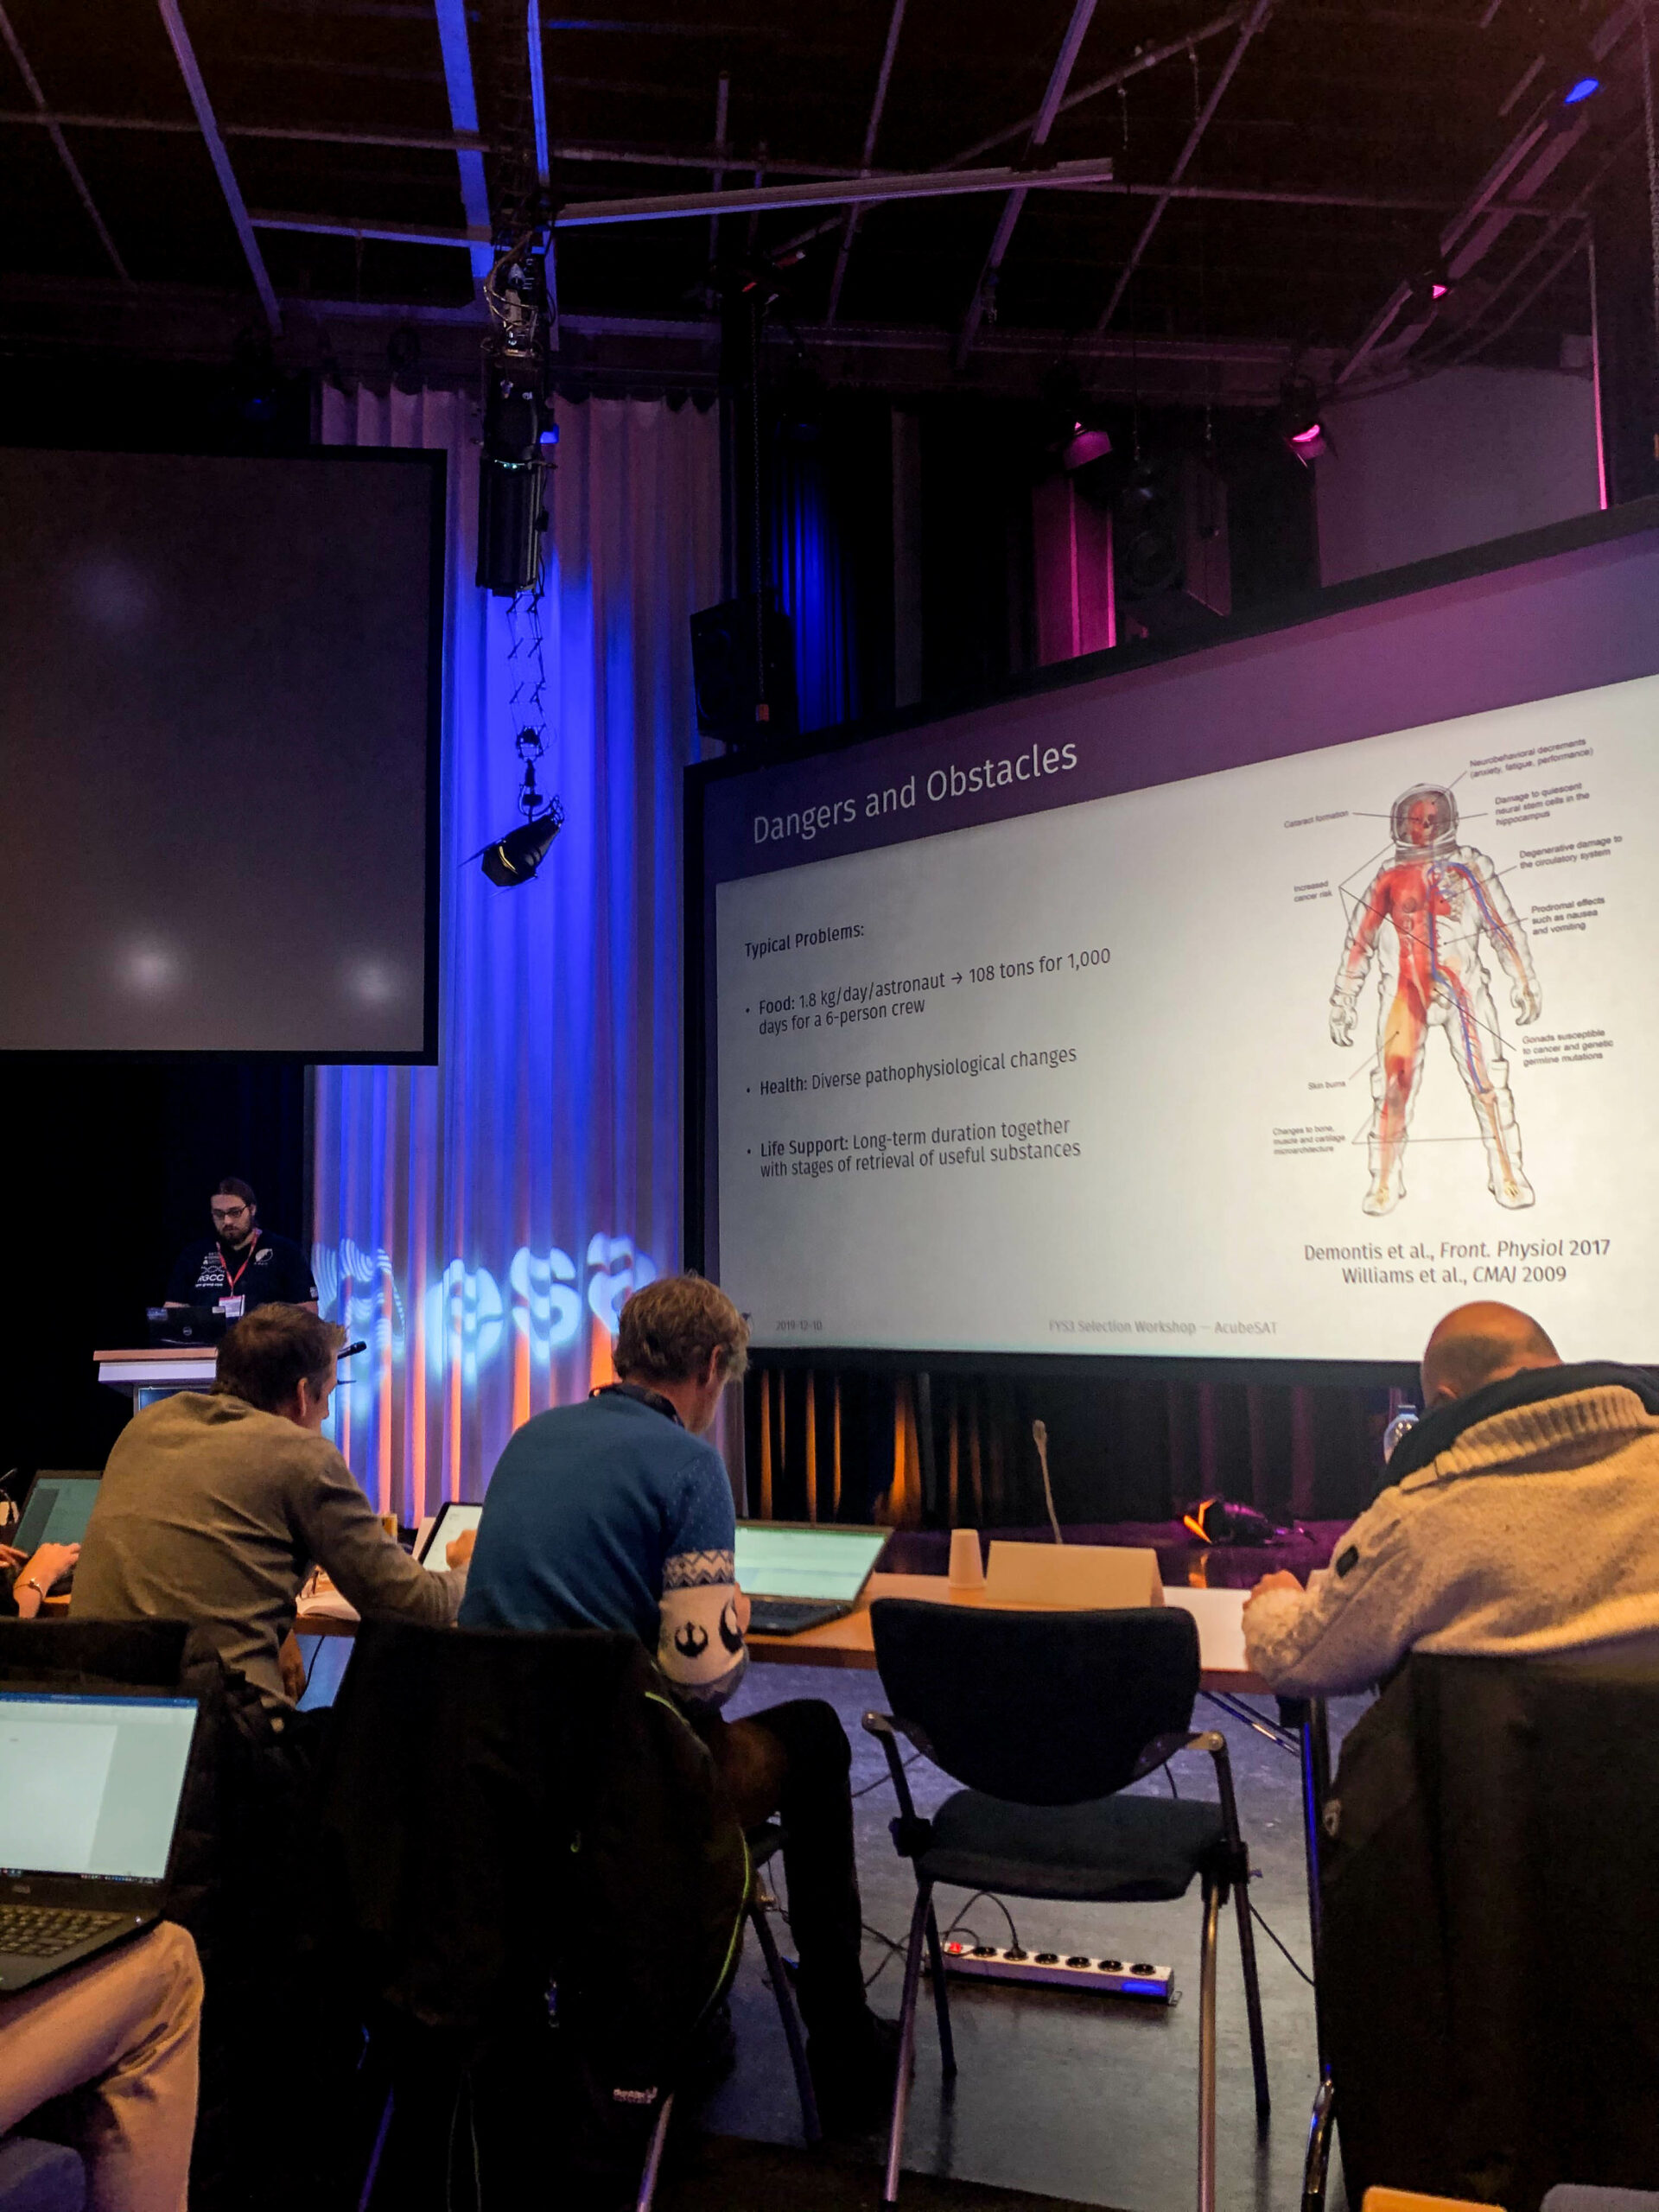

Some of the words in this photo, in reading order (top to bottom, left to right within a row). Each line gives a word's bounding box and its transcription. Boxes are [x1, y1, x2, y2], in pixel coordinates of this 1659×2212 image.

[753, 798, 856, 843] Dangers
[865, 776, 915, 817] and
[927, 743, 1077, 802] Obstacles
[1495, 792, 1529, 804] Damage
[1496, 804, 1521, 815] neural
[1523, 800, 1543, 810] stem
[1545, 797, 1564, 807] cells
[1576, 791, 1590, 800] the
[1496, 810, 1550, 826] hippocampus
[1519, 844, 1575, 859] Degenerative
[1576, 837, 1611, 848] damage
[1520, 861, 1533, 869] the
[1535, 854, 1578, 868] circulatory
[1580, 849, 1611, 861] system
[1531, 900, 1574, 913] Prodromal
[1576, 897, 1605, 907] effects
[1532, 915, 1552, 925] such
[1567, 909, 1599, 920] nausea
[1533, 926, 1548, 935] and
[1551, 922, 1586, 933] vomiting
[745, 936, 791, 960] Typical
[795, 924, 865, 949] Problems:
[760, 995, 796, 1015] Food:
[798, 992, 817, 1009] 1.8
[820, 972, 946, 1009] kg/day/astronaut
[969, 964, 995, 984] 108
[1000, 960, 1035, 980] tons
[1039, 955, 1064, 974] for
[1067, 948, 1111, 971] 1,000
[759, 1016, 788, 1036] days
[791, 1013, 810, 1031] for
[814, 1014, 823, 1028] a
[825, 1005, 887, 1033] 6-person
[891, 998, 925, 1017] crew
[1564, 1043, 1580, 1052] and
[760, 1077, 808, 1096] Health:
[811, 1071, 861, 1090] Diverse
[865, 1052, 1006, 1087] pathophysiological
[1010, 1046, 1077, 1070] changes
[760, 1141, 785, 1158] Life
[788, 1135, 849, 1160] Support:
[853, 1128, 926, 1154] Long-term
[931, 1123, 996, 1144] duration
[1001, 1117, 1071, 1142] together
[760, 1160, 788, 1178] with
[791, 1158, 834, 1178] stages
[837, 1154, 852, 1173] of
[855, 1152, 915, 1172] retrieval
[918, 1149, 935, 1167] of
[938, 1146, 987, 1166] useful
[990, 1140, 1082, 1163] substances
[1304, 1243, 1383, 1262] Demontis
[1387, 1244, 1405, 1260] et
[1409, 1243, 1435, 1262] al.,
[1440, 1241, 1491, 1259] Front.
[1497, 1239, 1564, 1262] Physiol
[1569, 1239, 1611, 1256] 2017
[1342, 1267, 1414, 1284] Williams
[1420, 1268, 1437, 1283] et
[1441, 1267, 1468, 1285] al.,
[1472, 1266, 1516, 1283] CMAJ
[1522, 1266, 1567, 1282] 2009
[423, 1231, 658, 1365] esa
[1079, 1320, 1131, 1333] Selection
[1135, 1320, 1197, 1336] Workshop
[1214, 1321, 1278, 1335] AcubeSAT
